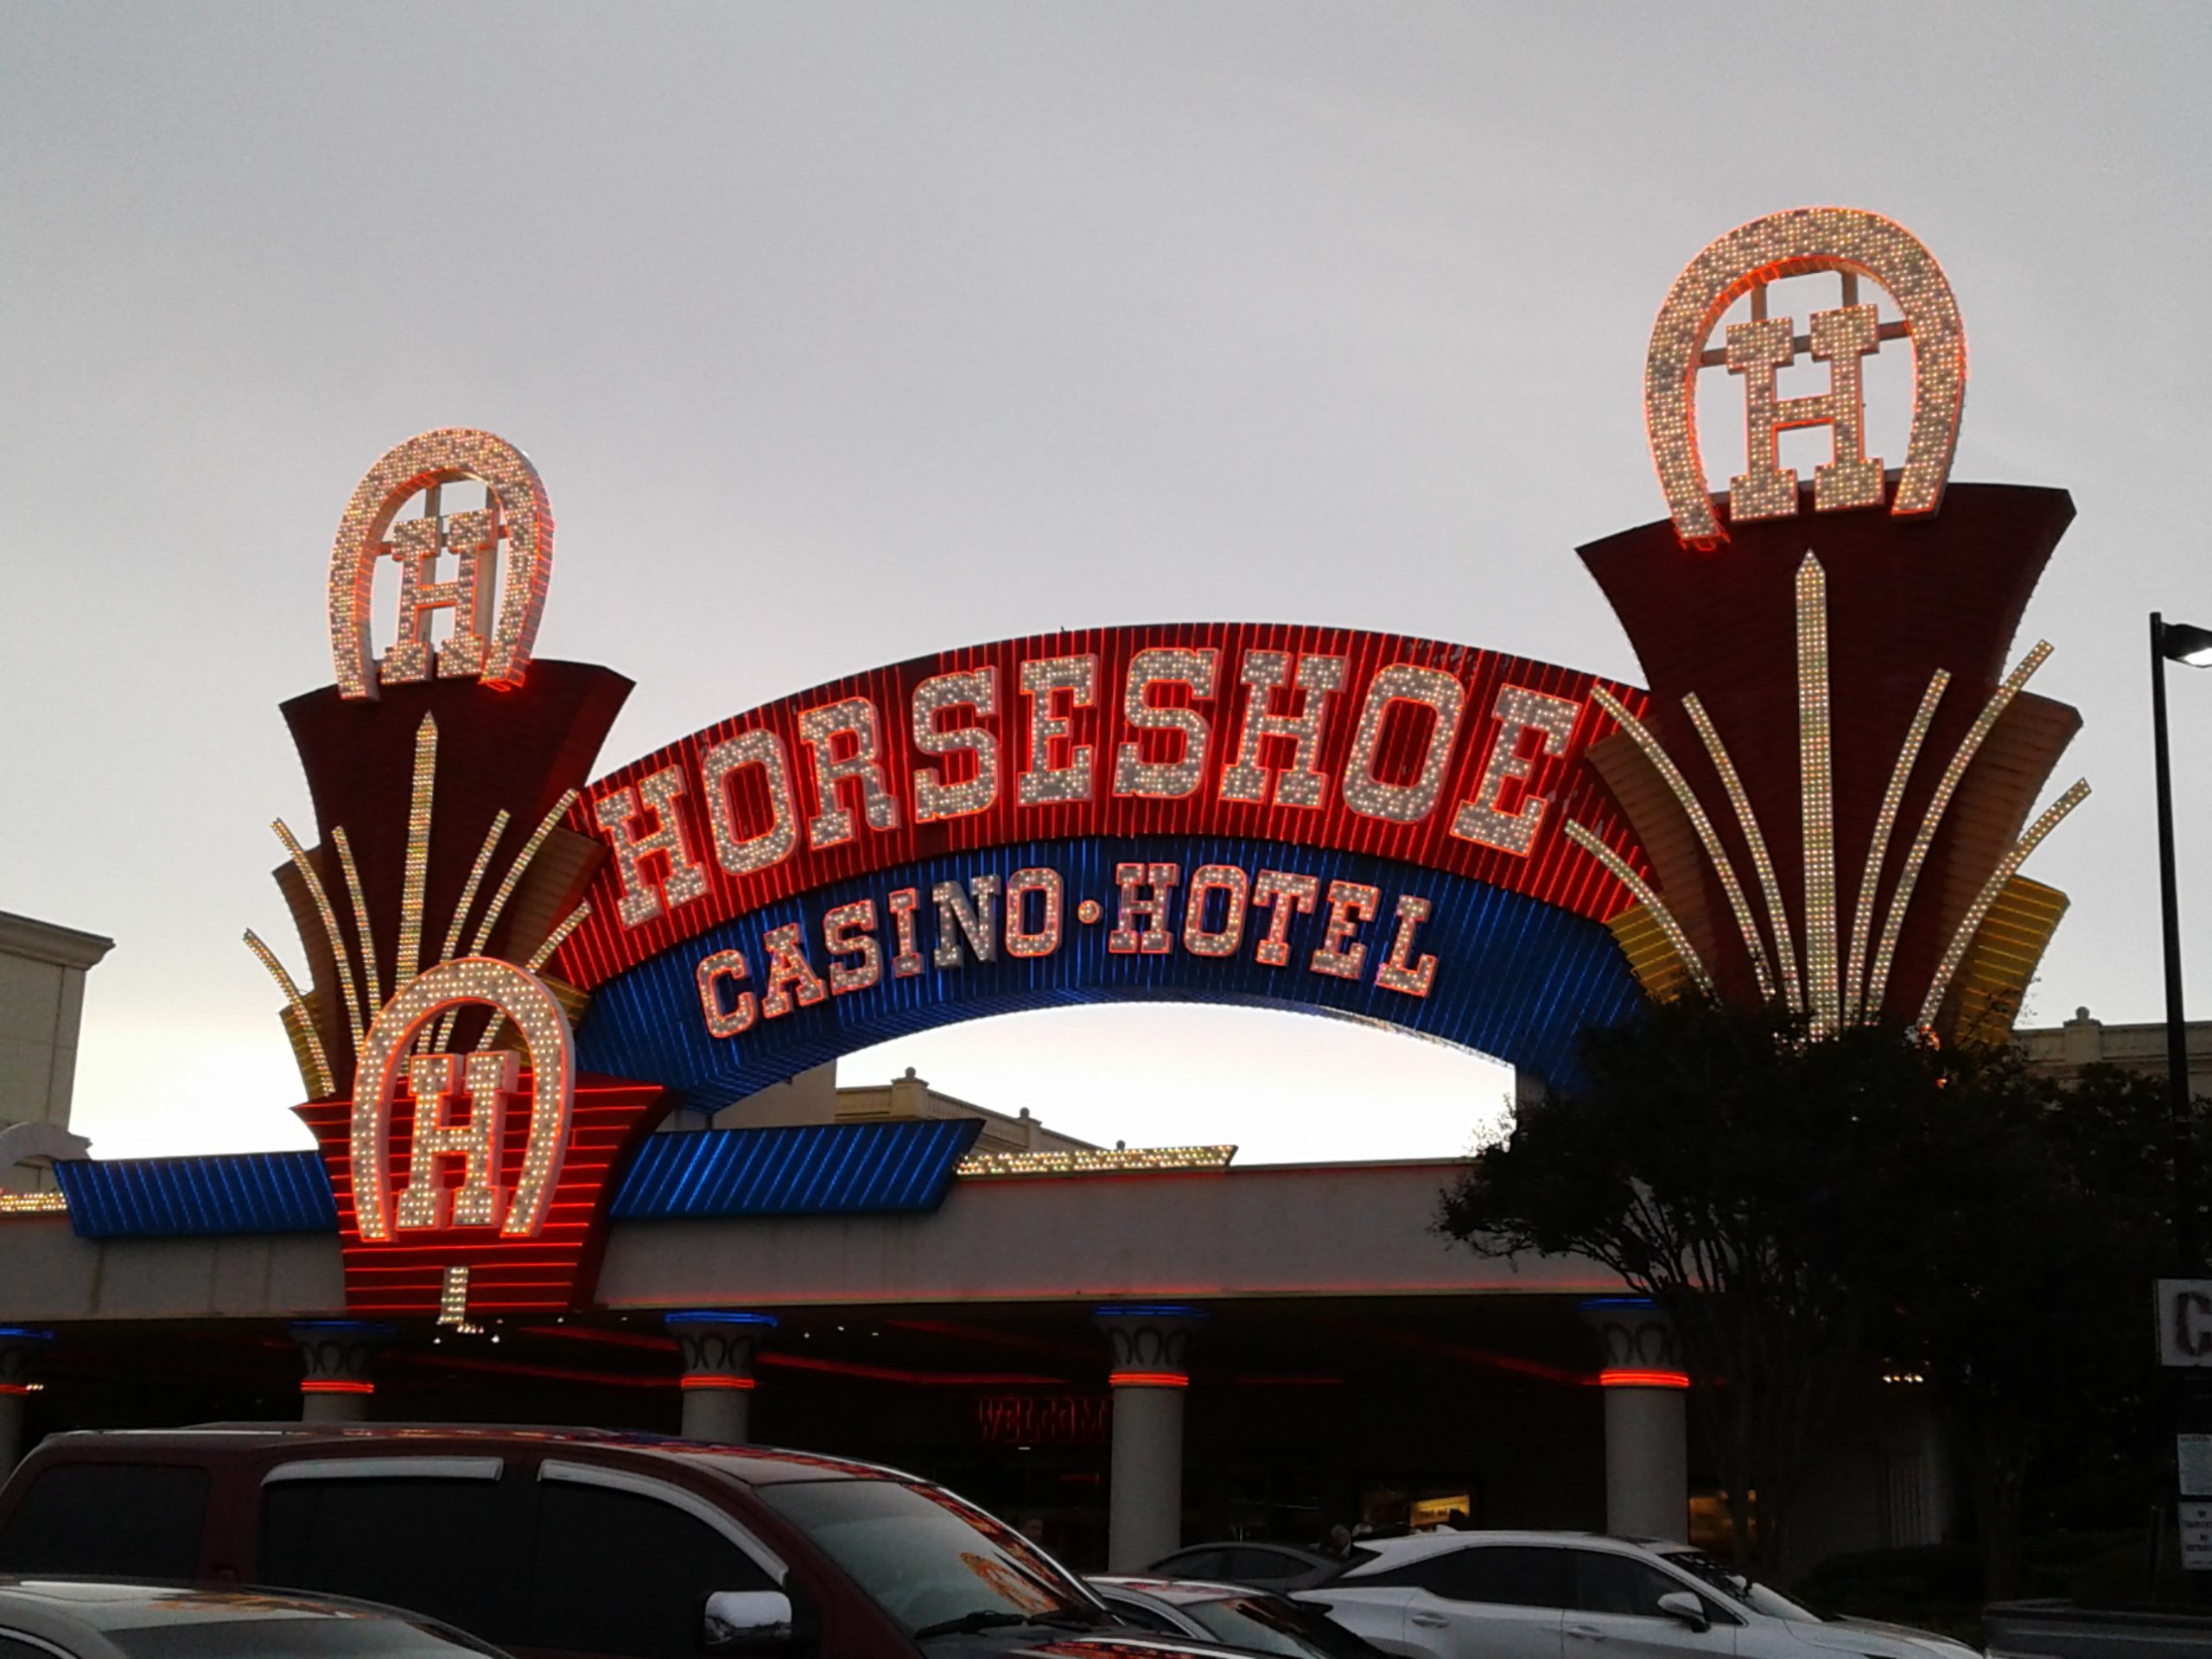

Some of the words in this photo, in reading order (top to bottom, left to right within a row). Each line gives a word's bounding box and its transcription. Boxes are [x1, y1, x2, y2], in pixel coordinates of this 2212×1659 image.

[1726, 303, 1885, 521] H
[380, 508, 496, 685] H
[593, 646, 1583, 931] HORSESHOE
[695, 867, 1064, 1039] CASINO
[1108, 861, 1439, 999] HOTEL
[395, 1050, 518, 1230] H
[976, 1395, 1112, 1444] WELCOM
